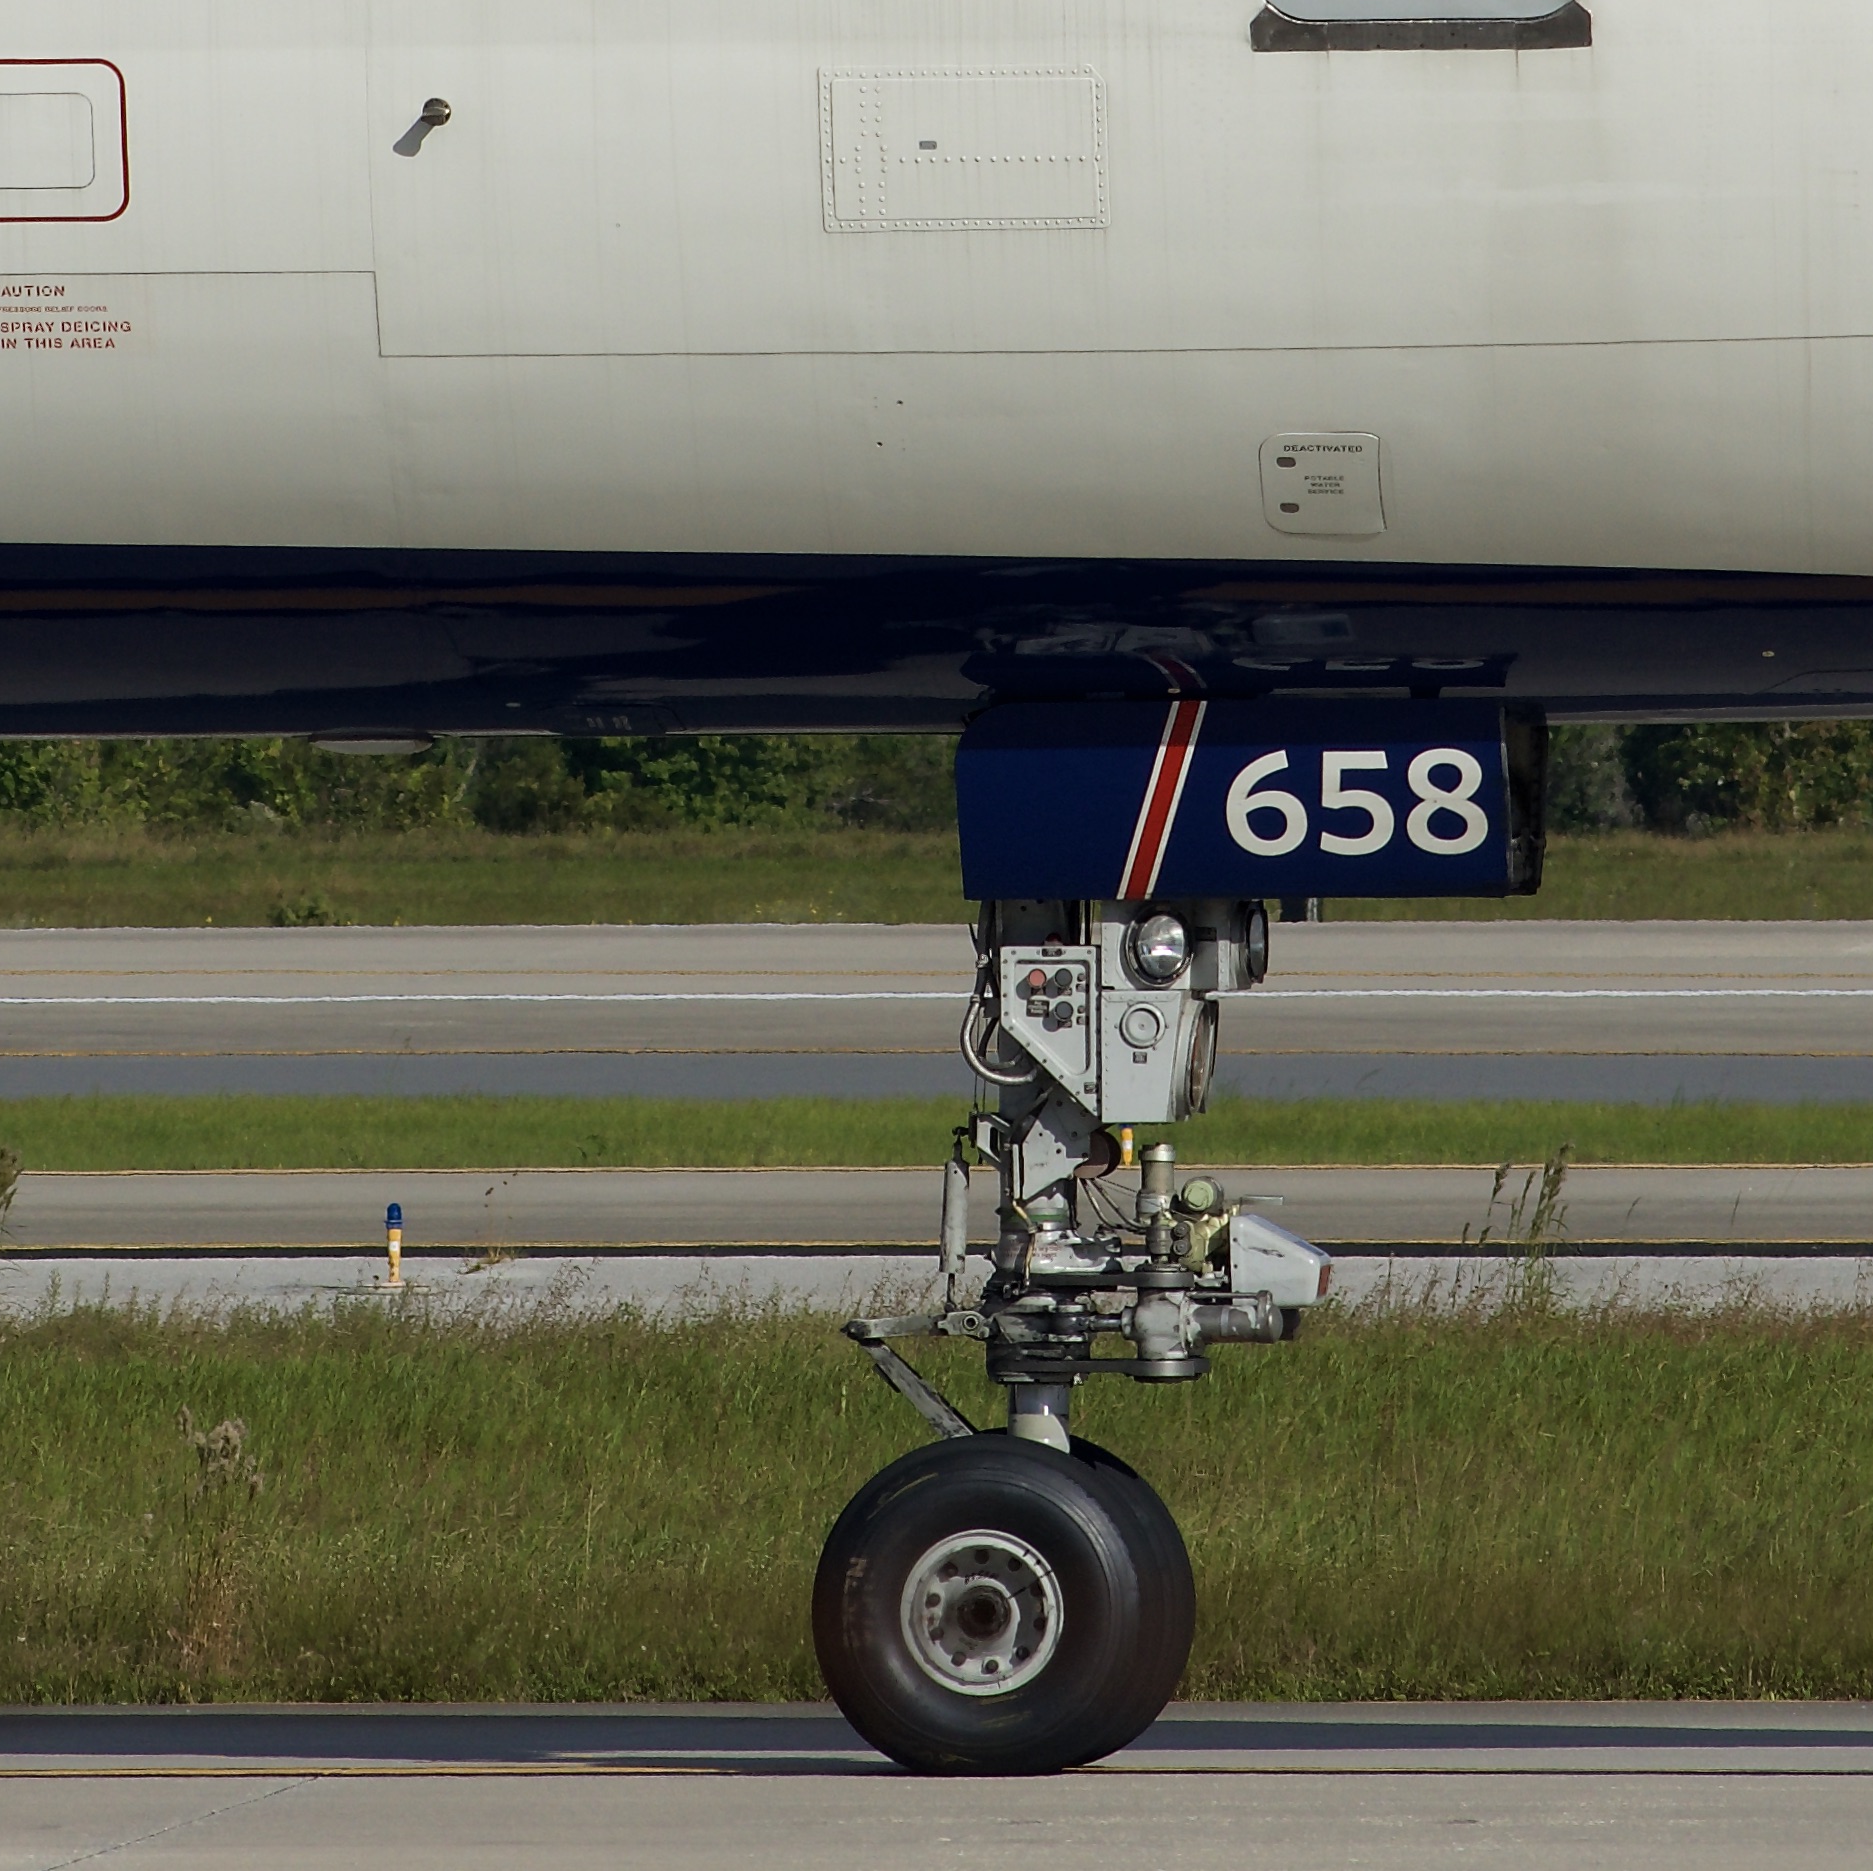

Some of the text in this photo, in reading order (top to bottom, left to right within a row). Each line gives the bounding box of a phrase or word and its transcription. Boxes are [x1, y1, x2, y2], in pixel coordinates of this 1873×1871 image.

[0, 322, 54, 333] SPRAY
[61, 321, 132, 332] DEICING
[1, 338, 17, 349] IN
[24, 338, 63, 349] THIS
[70, 337, 115, 349] AREA
[1283, 445, 1363, 453] DEACTIVATED
[1226, 748, 1488, 856] 658
